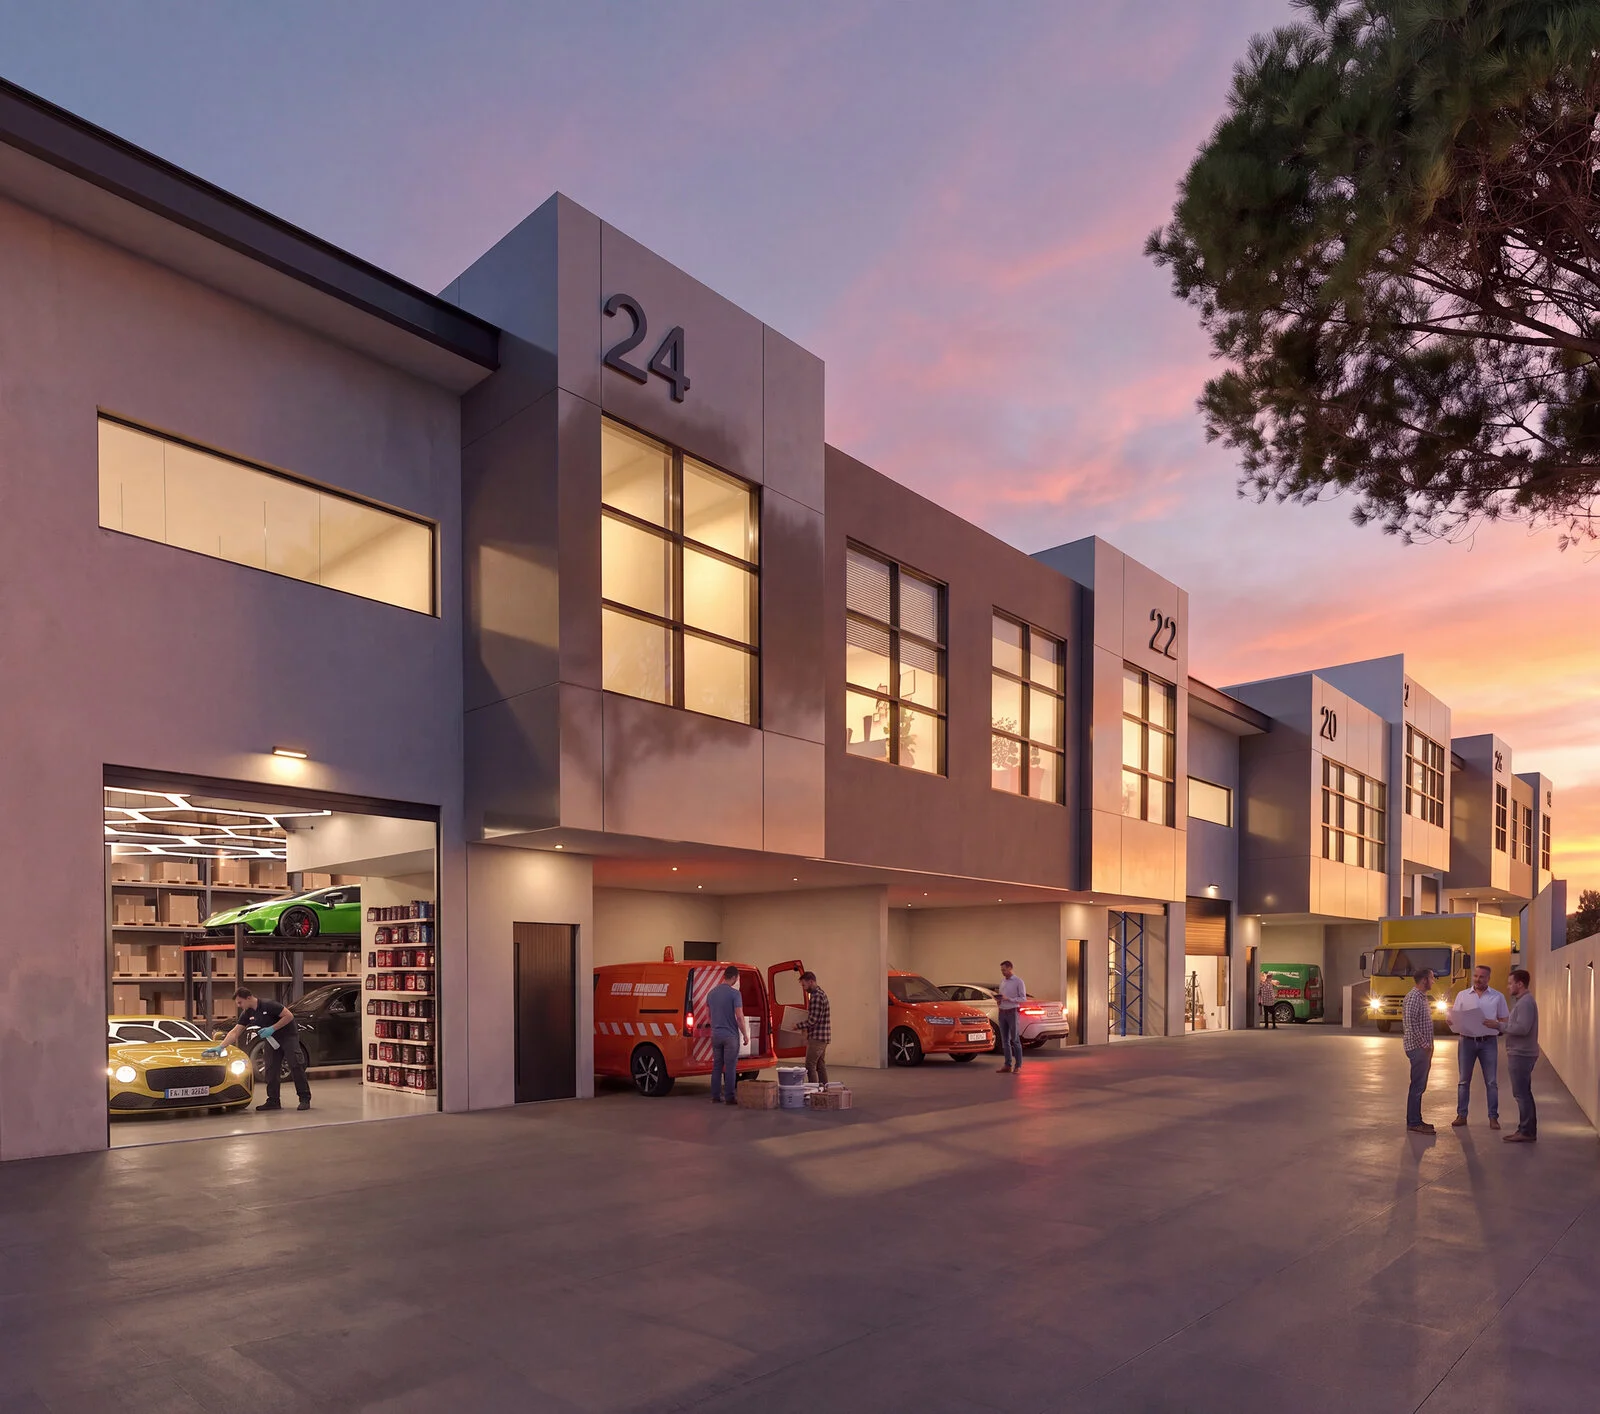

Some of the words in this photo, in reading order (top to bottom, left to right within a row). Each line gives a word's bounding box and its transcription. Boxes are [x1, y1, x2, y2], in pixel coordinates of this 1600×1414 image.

[602, 293, 691, 404] 24
[1148, 608, 1178, 661] 22
[1319, 705, 1337, 742] 20
